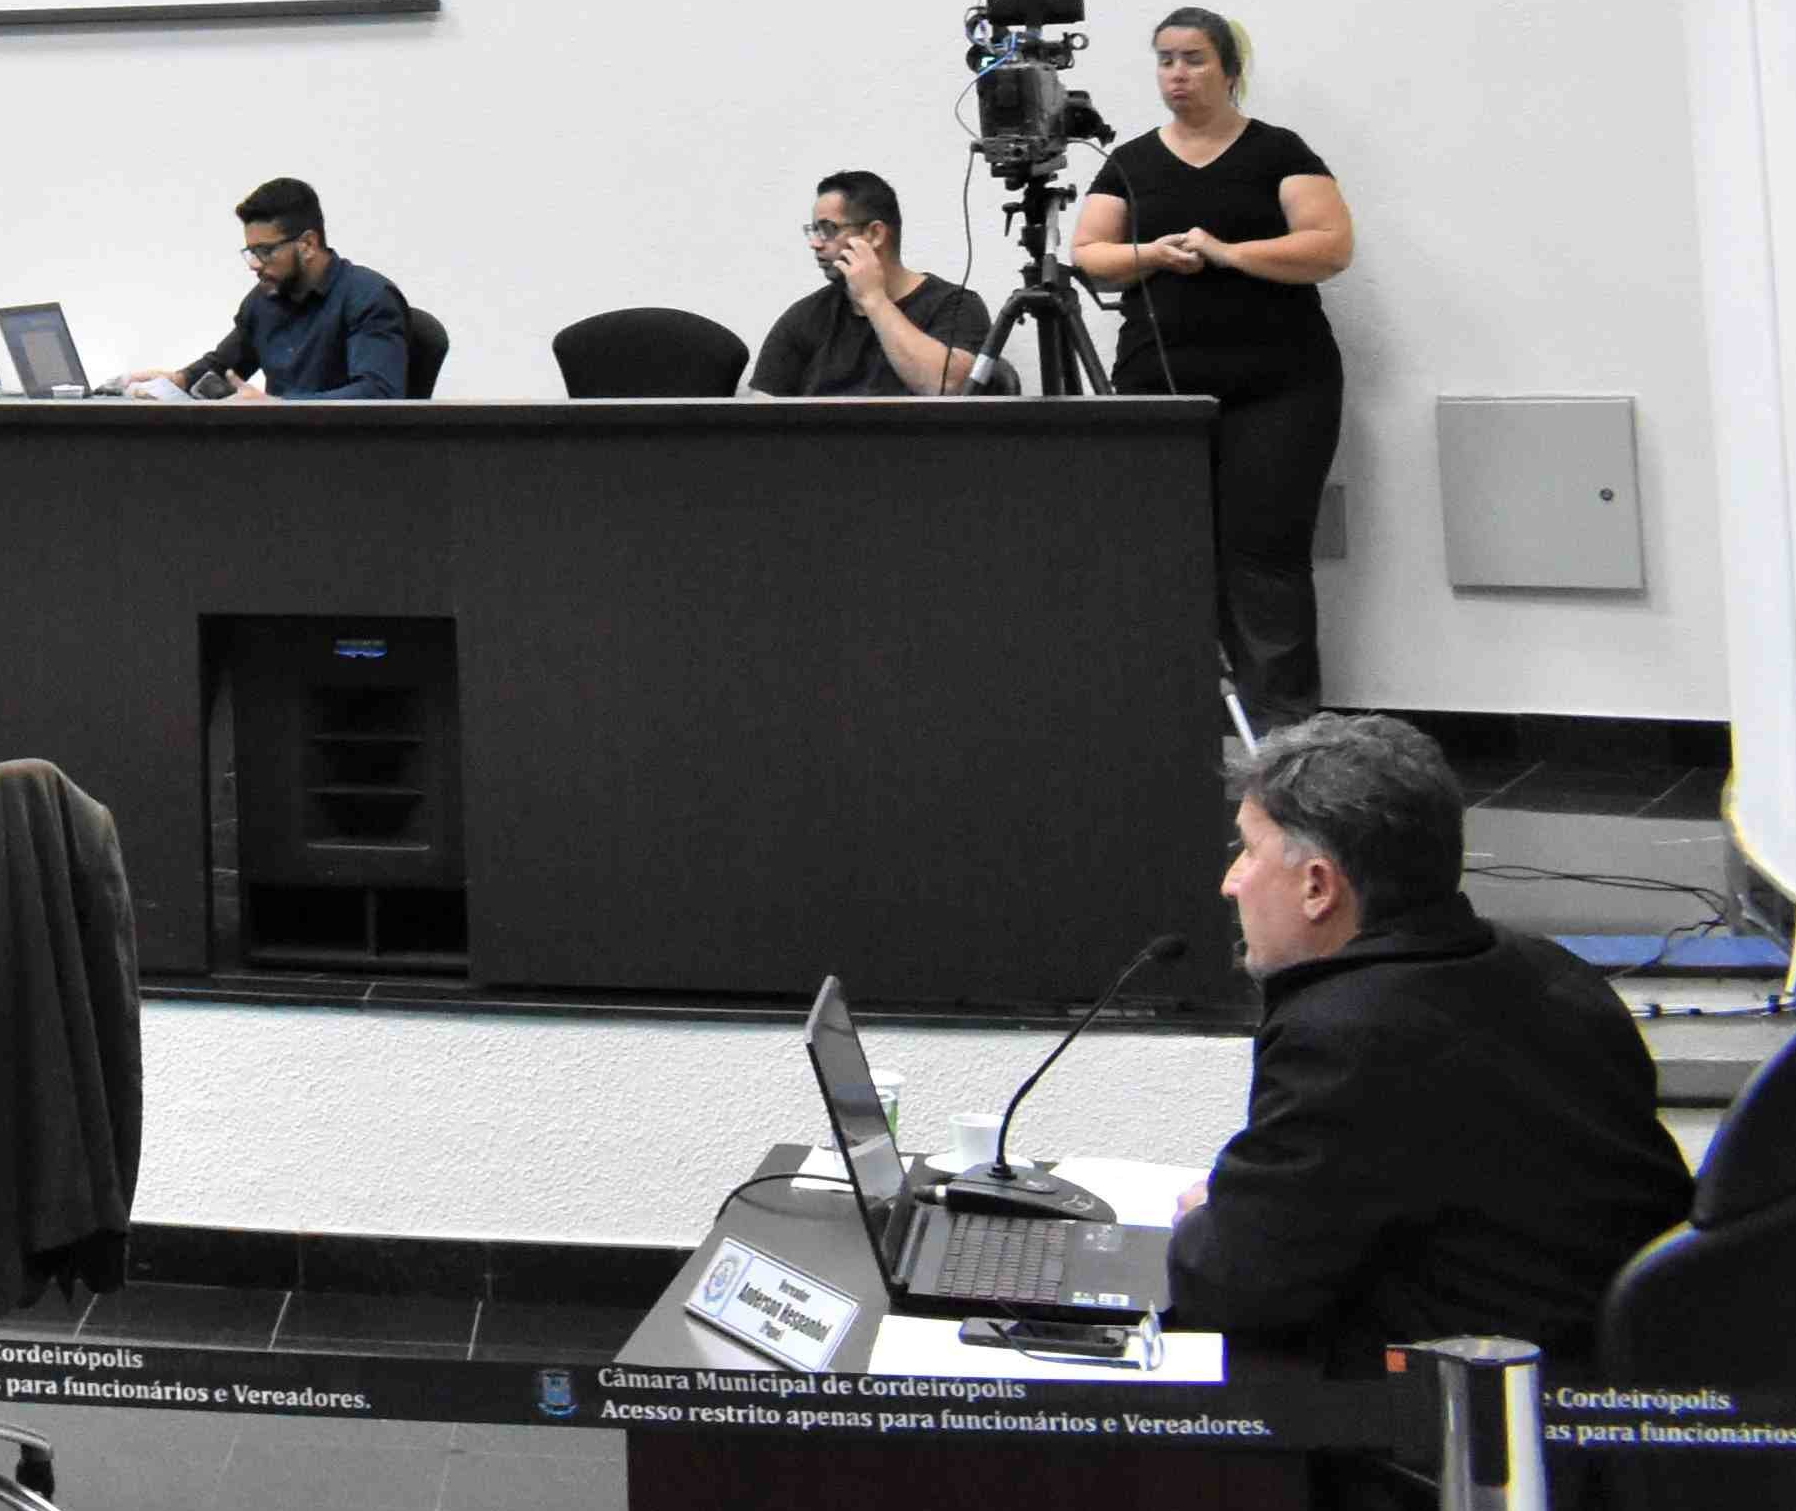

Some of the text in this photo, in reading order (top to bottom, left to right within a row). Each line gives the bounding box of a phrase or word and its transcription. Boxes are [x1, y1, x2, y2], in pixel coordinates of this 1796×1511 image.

[6, 1376, 59, 1398] para
[63, 1376, 208, 1404] funcionários
[214, 1387, 228, 1404] e
[231, 1383, 372, 1411] Vereadores.
[597, 1367, 1027, 1403] Câmara Municipal de Cordeirópolis
[1557, 1386, 1733, 1416] Cordeirópolis
[600, 1399, 1273, 1437] Acesso restrito apenas para funcionários e Vereadores.
[1576, 1422, 1636, 1446] para
